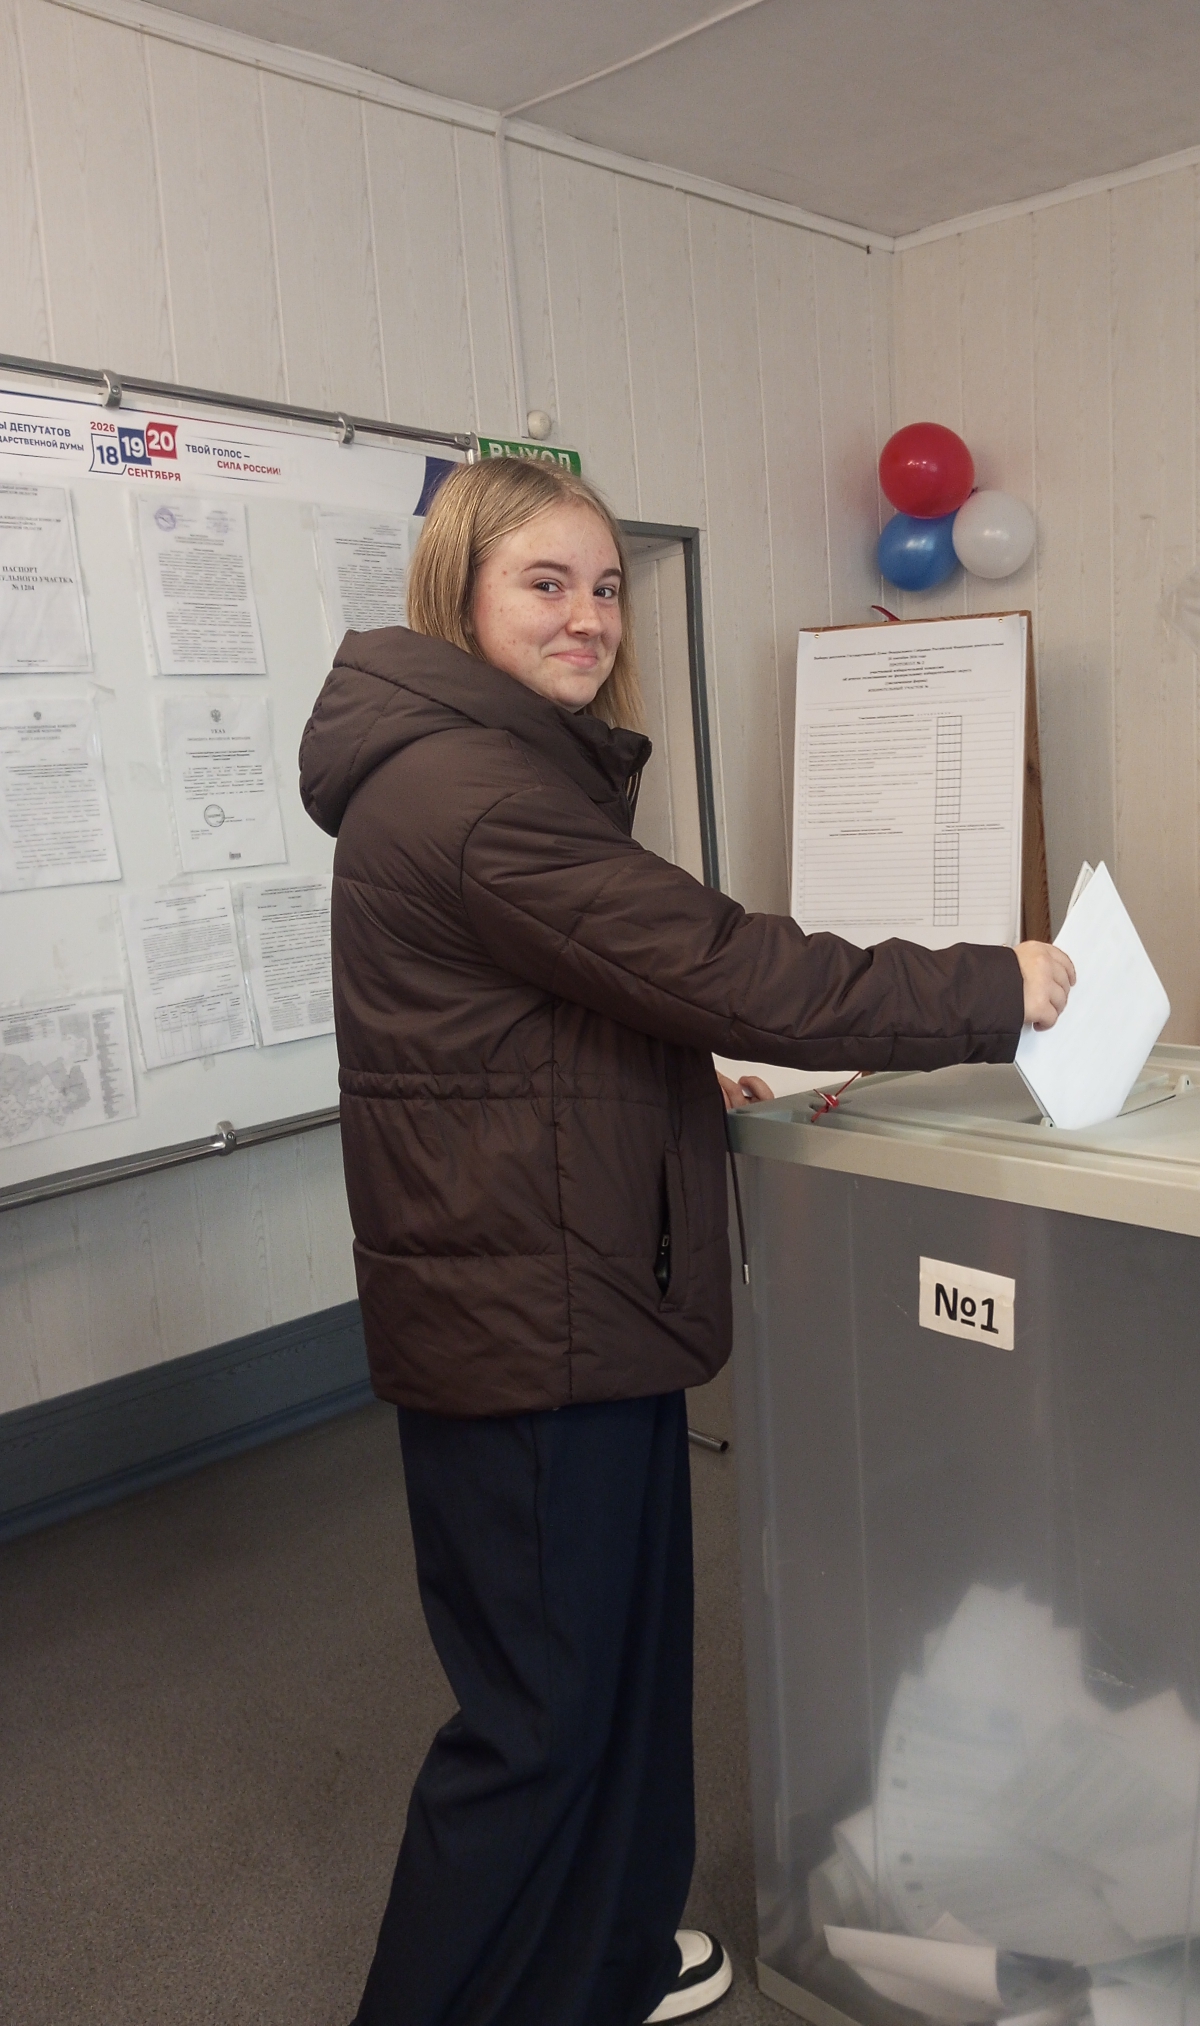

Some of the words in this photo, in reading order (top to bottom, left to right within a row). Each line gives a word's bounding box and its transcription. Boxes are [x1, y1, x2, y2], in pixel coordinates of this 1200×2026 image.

[9, 422, 71, 437] ДЕПУТАТОВ
[90, 421, 116, 433] 2026
[59, 442, 85, 451] ДУМЫ
[96, 445, 119, 465] 18
[121, 436, 145, 458] 19
[147, 429, 175, 452] 20
[185, 443, 211, 455] ТВОЙ
[212, 447, 242, 459] ГОЛОС
[127, 467, 181, 481] СЕНТЯБРЯ
[217, 460, 242, 471] СИЛА
[243, 463, 281, 475] РОССИИ!
[38, 576, 74, 584] УЧАСТКА
[934, 1282, 999, 1334] №1
